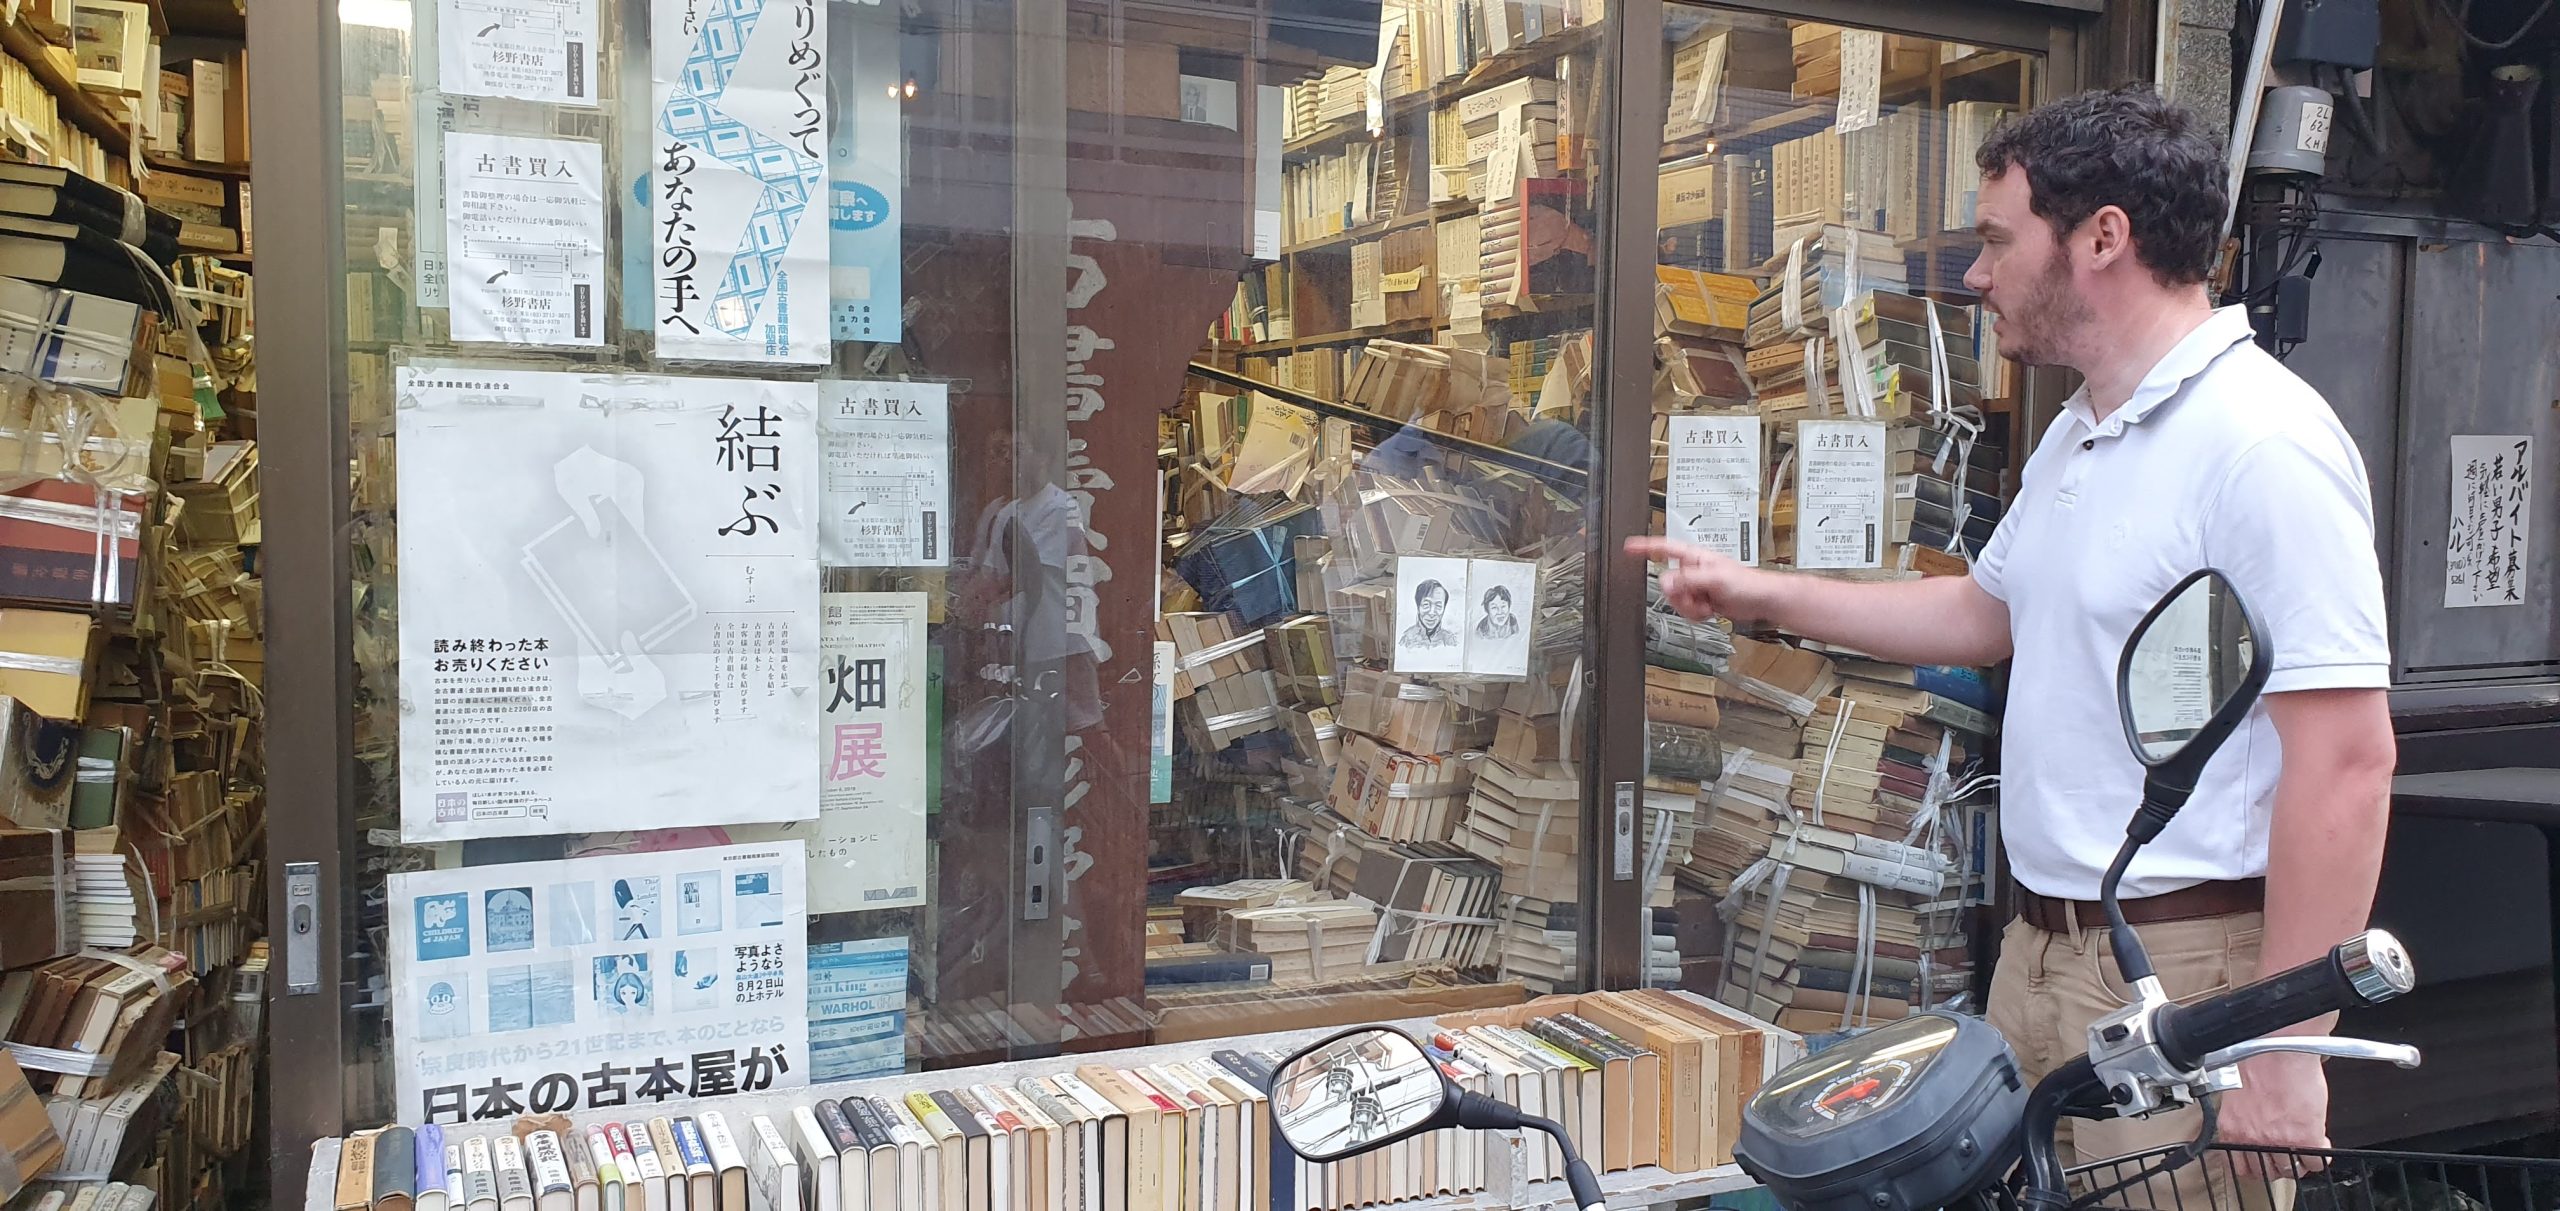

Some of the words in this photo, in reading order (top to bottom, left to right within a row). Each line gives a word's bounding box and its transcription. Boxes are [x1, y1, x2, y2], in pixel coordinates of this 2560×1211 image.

[493, 51, 543, 67] 杉野書店
[788, 0, 822, 159] りめぐって
[475, 153, 573, 178] 古書買入
[462, 190, 587, 206] 書籍御整理の場合は一応御気軽に
[462, 201, 517, 212] 御相談下さい。
[463, 223, 500, 233] たします。
[659, 142, 701, 335] あなたの手へ
[502, 296, 551, 310] 杉野書店
[777, 270, 789, 356] 全国古書籍商組合
[765, 324, 776, 356] 加盟店
[408, 380, 509, 390] 全国古書籍商組合連合会
[840, 397, 923, 416] 古書買入
[1685, 430, 1743, 444] 古書買入
[1817, 433, 1868, 448] 古書買入
[715, 404, 783, 538] 結ぶ
[2486, 453, 2504, 591] 若い男子希望
[2504, 440, 2529, 601] アルバイト募集
[861, 525, 904, 536] 杉野書店
[2450, 517, 2465, 553] ハル
[434, 637, 549, 654] 読み終わった本
[726, 622, 735, 689] 全国の古書組合は
[767, 622, 775, 697] 古書が人と人を結ぶ
[780, 622, 789, 688] 古書が知識を結ぶ
[434, 657, 549, 673] お売りください
[713, 622, 721, 724] 古書店の手と手を結びます
[826, 653, 886, 714] 畑
[828, 722, 888, 782] 展
[637, 893, 657, 901] London
[423, 927, 463, 937] CHILDREN
[433, 934, 461, 942] JAPAN
[734, 943, 783, 959] 写真よさ
[736, 957, 784, 973] ようなら
[737, 977, 784, 992] 8月2日山
[736, 989, 785, 1003] の上ホテル
[821, 1000, 875, 1015] WARHOL
[421, 1015, 785, 1077] 奈良時代から21世紀まで、本のことなら
[422, 1042, 790, 1126] 日本の古本屋が
